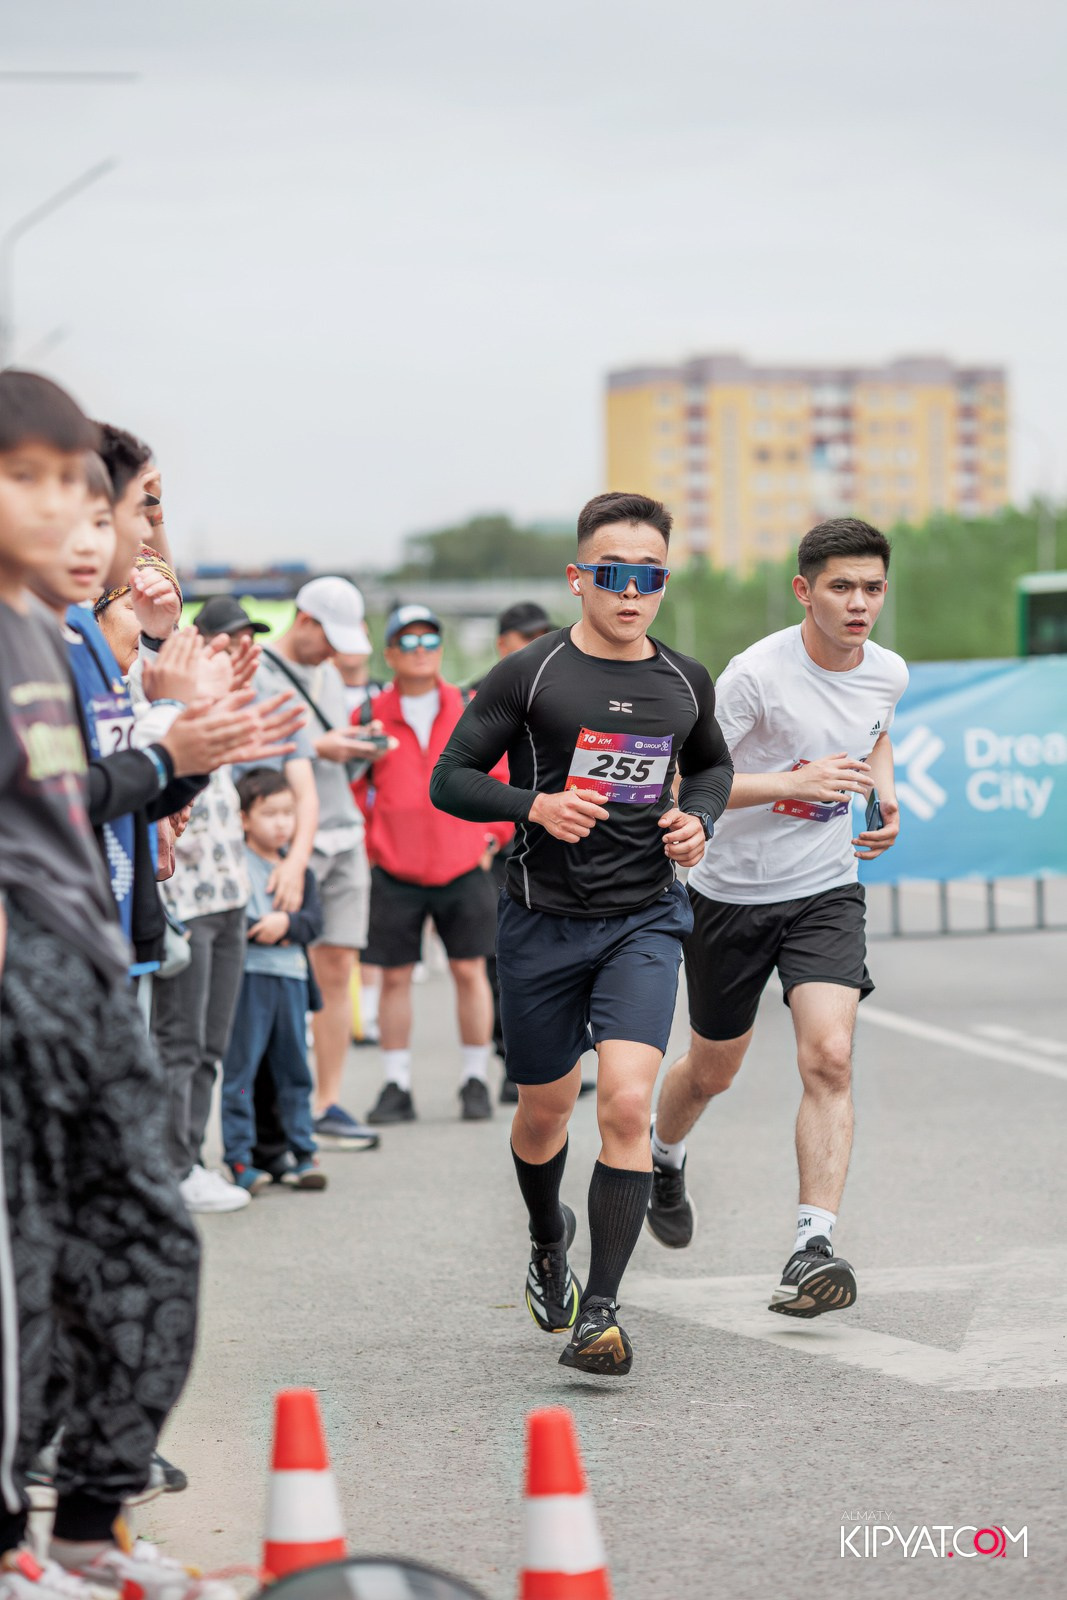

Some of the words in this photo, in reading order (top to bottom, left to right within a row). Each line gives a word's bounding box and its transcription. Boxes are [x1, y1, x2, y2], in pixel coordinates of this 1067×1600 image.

[583, 734, 596, 743] 10
[588, 754, 655, 782] 255
[966, 770, 1054, 818] City
